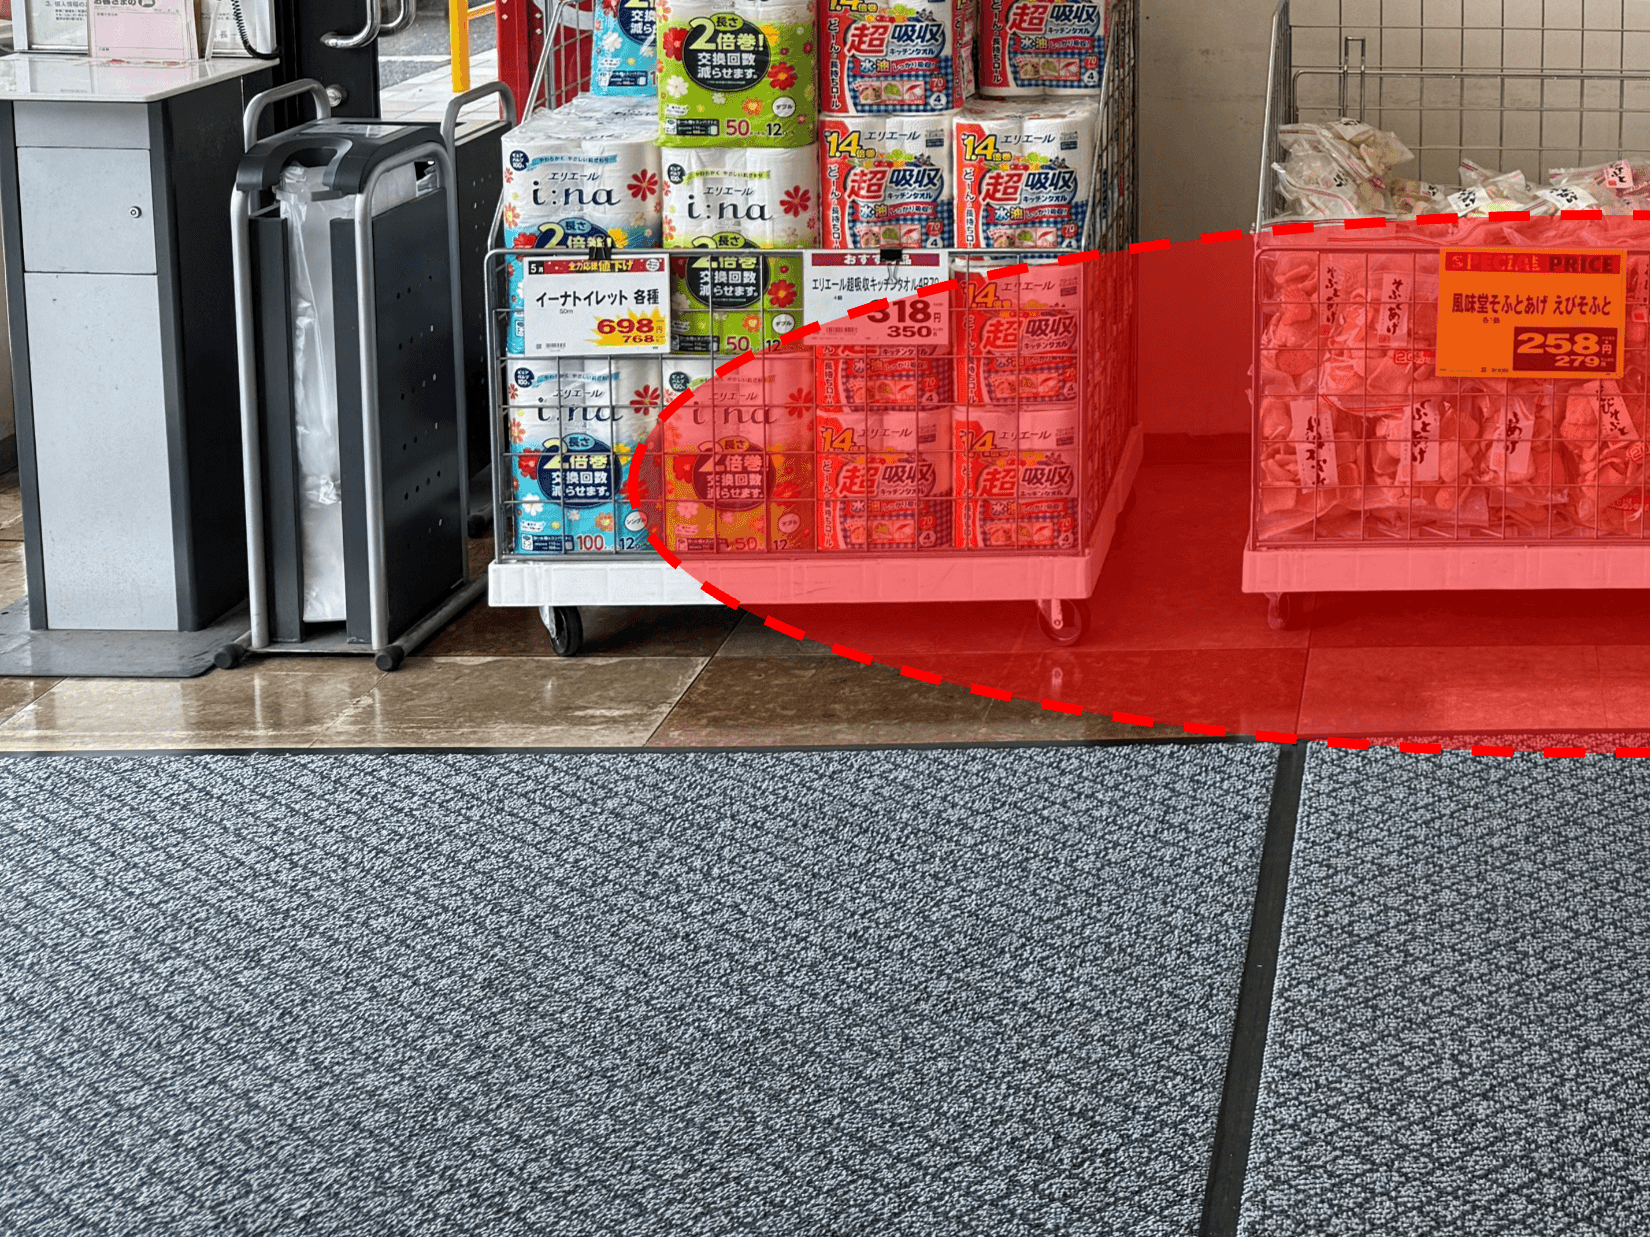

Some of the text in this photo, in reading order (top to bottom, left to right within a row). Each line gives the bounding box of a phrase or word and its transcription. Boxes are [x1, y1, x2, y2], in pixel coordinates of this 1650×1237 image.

[716, 16, 738, 28] 長さ
[889, 47, 935, 56] キッチンタオル
[698, 52, 756, 65] 交換回数
[697, 67, 758, 79] 減らせます。
[864, 131, 920, 142] エリエール
[1000, 134, 1055, 144] エリエール
[887, 192, 933, 201] キッチンタオル
[1022, 195, 1068, 203] キッチンタオル
[844, 255, 912, 265] おすす品
[1452, 253, 1613, 273] SPECIAL PRICE
[536, 288, 659, 307] イーナトイレット 各種
[1452, 293, 1612, 316] 風味堂そふとあげ えびそふと
[597, 318, 654, 334] 698
[887, 325, 932, 338] 350
[1516, 332, 1600, 354] 258
[1554, 355, 1600, 367] 279
